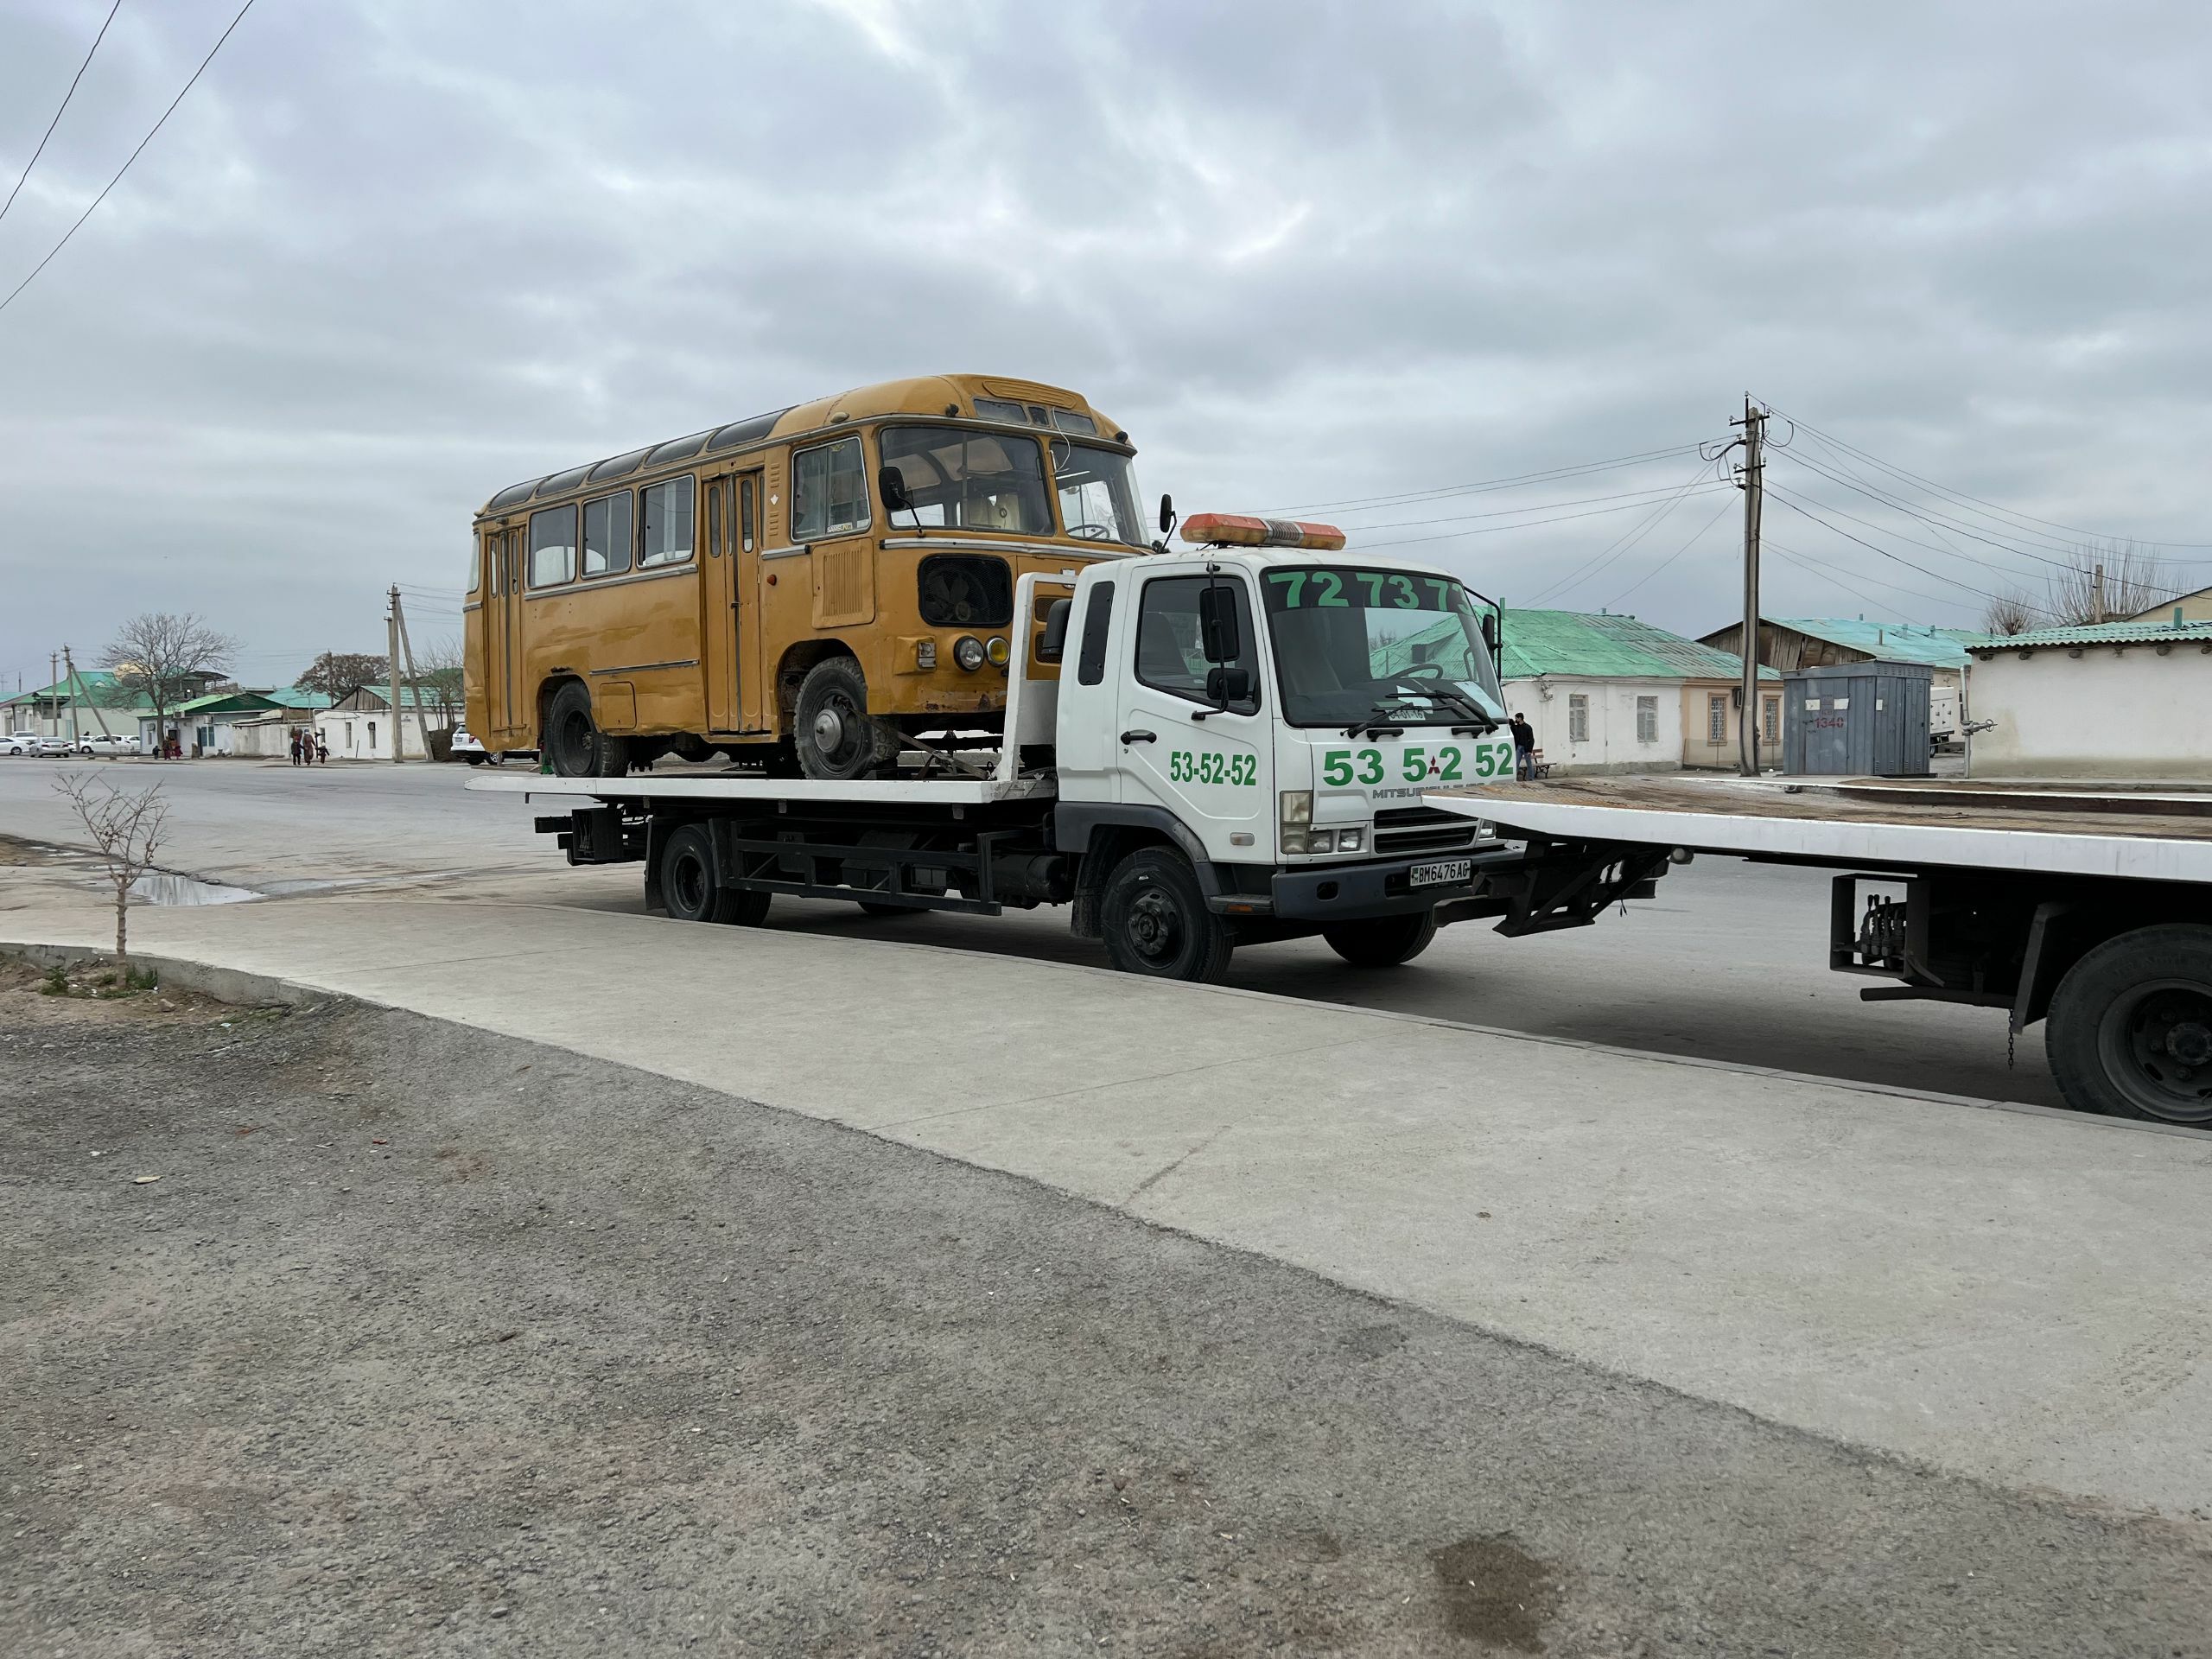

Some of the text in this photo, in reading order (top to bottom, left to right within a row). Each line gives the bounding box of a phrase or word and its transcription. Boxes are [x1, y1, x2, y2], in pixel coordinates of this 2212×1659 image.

[1268, 571, 1475, 616] 72 73 73
[1815, 716, 1844, 728] 1340
[1170, 751, 1256, 786] 53-52-52
[1322, 748, 1385, 786] 53
[1475, 742, 1514, 777] 52
[1372, 784, 1450, 798] MITSUB
[1419, 861, 1469, 883] BM6476AG
